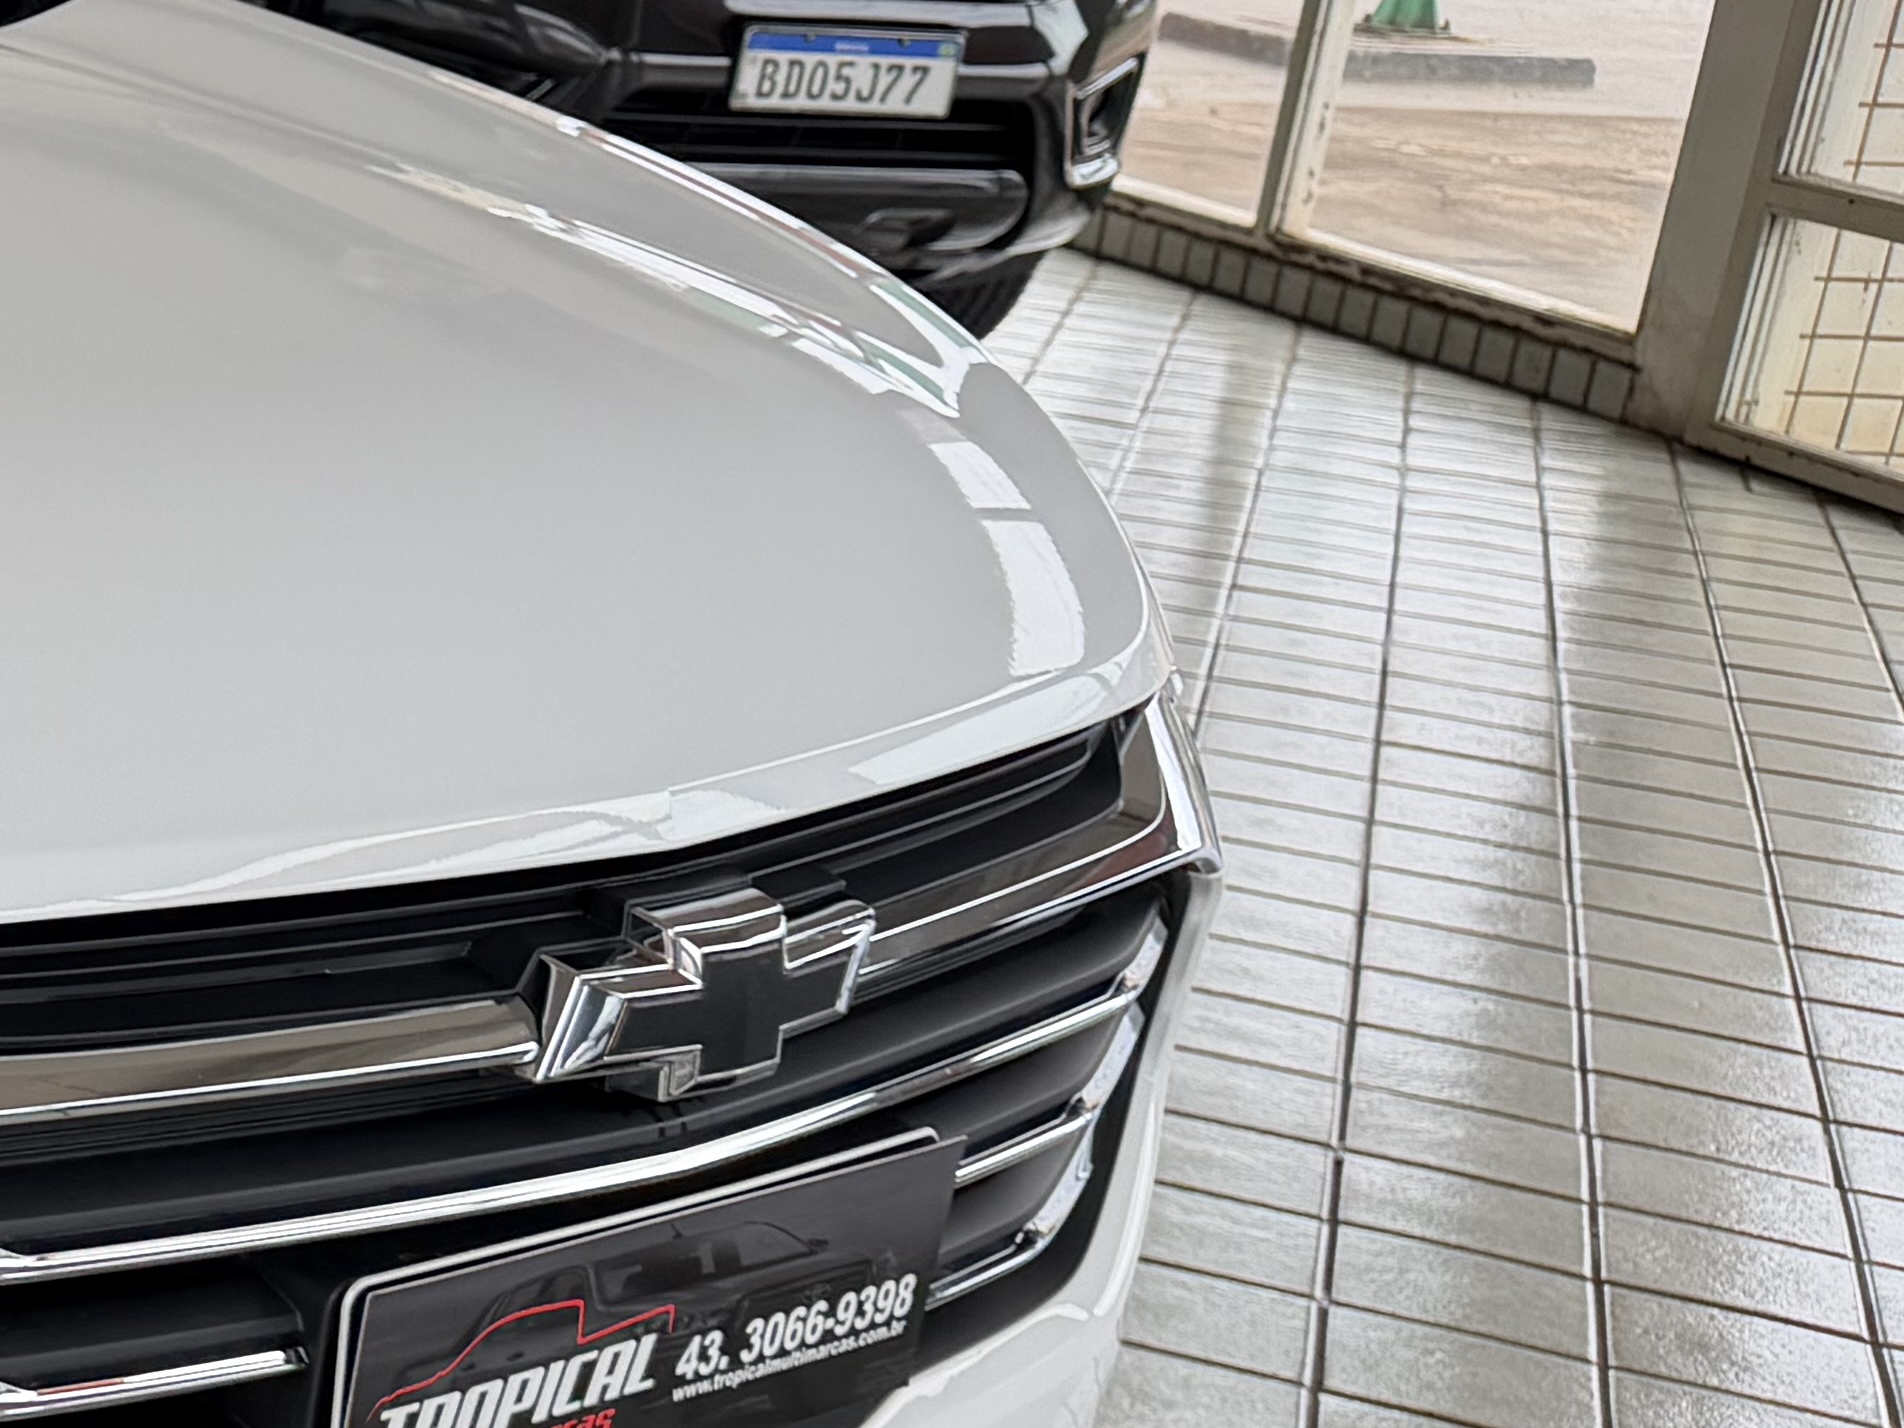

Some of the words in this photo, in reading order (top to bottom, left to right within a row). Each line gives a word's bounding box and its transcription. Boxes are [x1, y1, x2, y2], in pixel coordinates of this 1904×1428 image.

[672, 1320, 907, 1401] www.tropicalmultimarcas.com.br
[675, 1329, 730, 1380] 43.
[739, 1273, 918, 1364] 3066-9398
